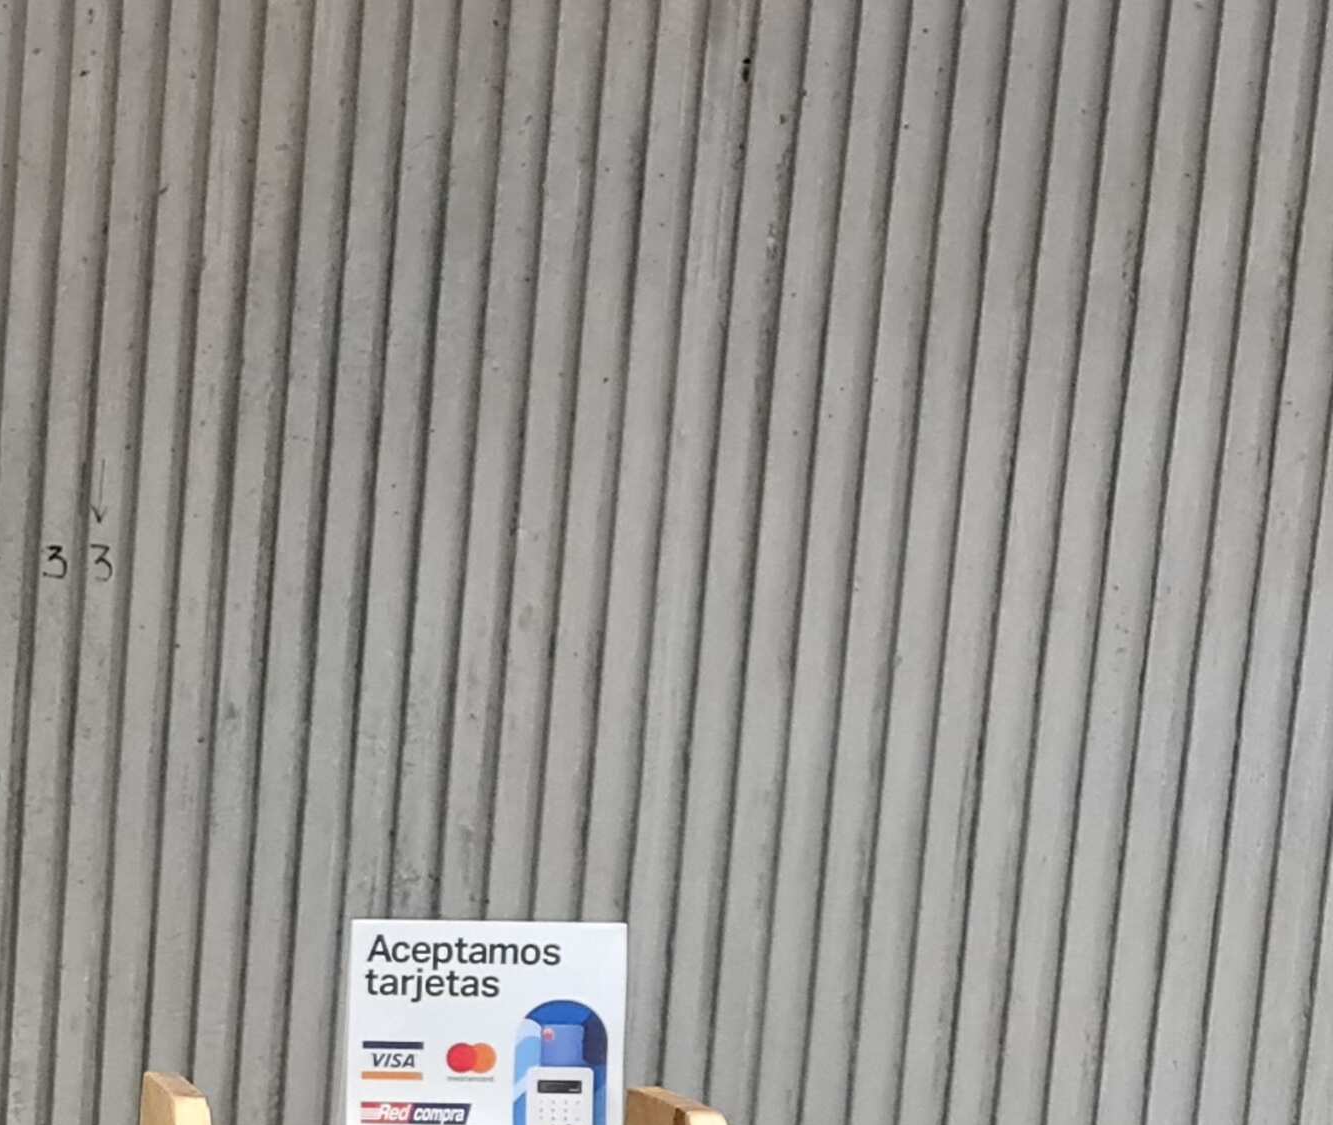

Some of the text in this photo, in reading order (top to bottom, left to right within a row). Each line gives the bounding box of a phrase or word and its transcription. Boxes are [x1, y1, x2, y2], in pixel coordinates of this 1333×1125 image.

[367, 934, 561, 970] Aceptamos
[365, 968, 500, 1002] tarjetas
[372, 1053, 415, 1068] VISA
